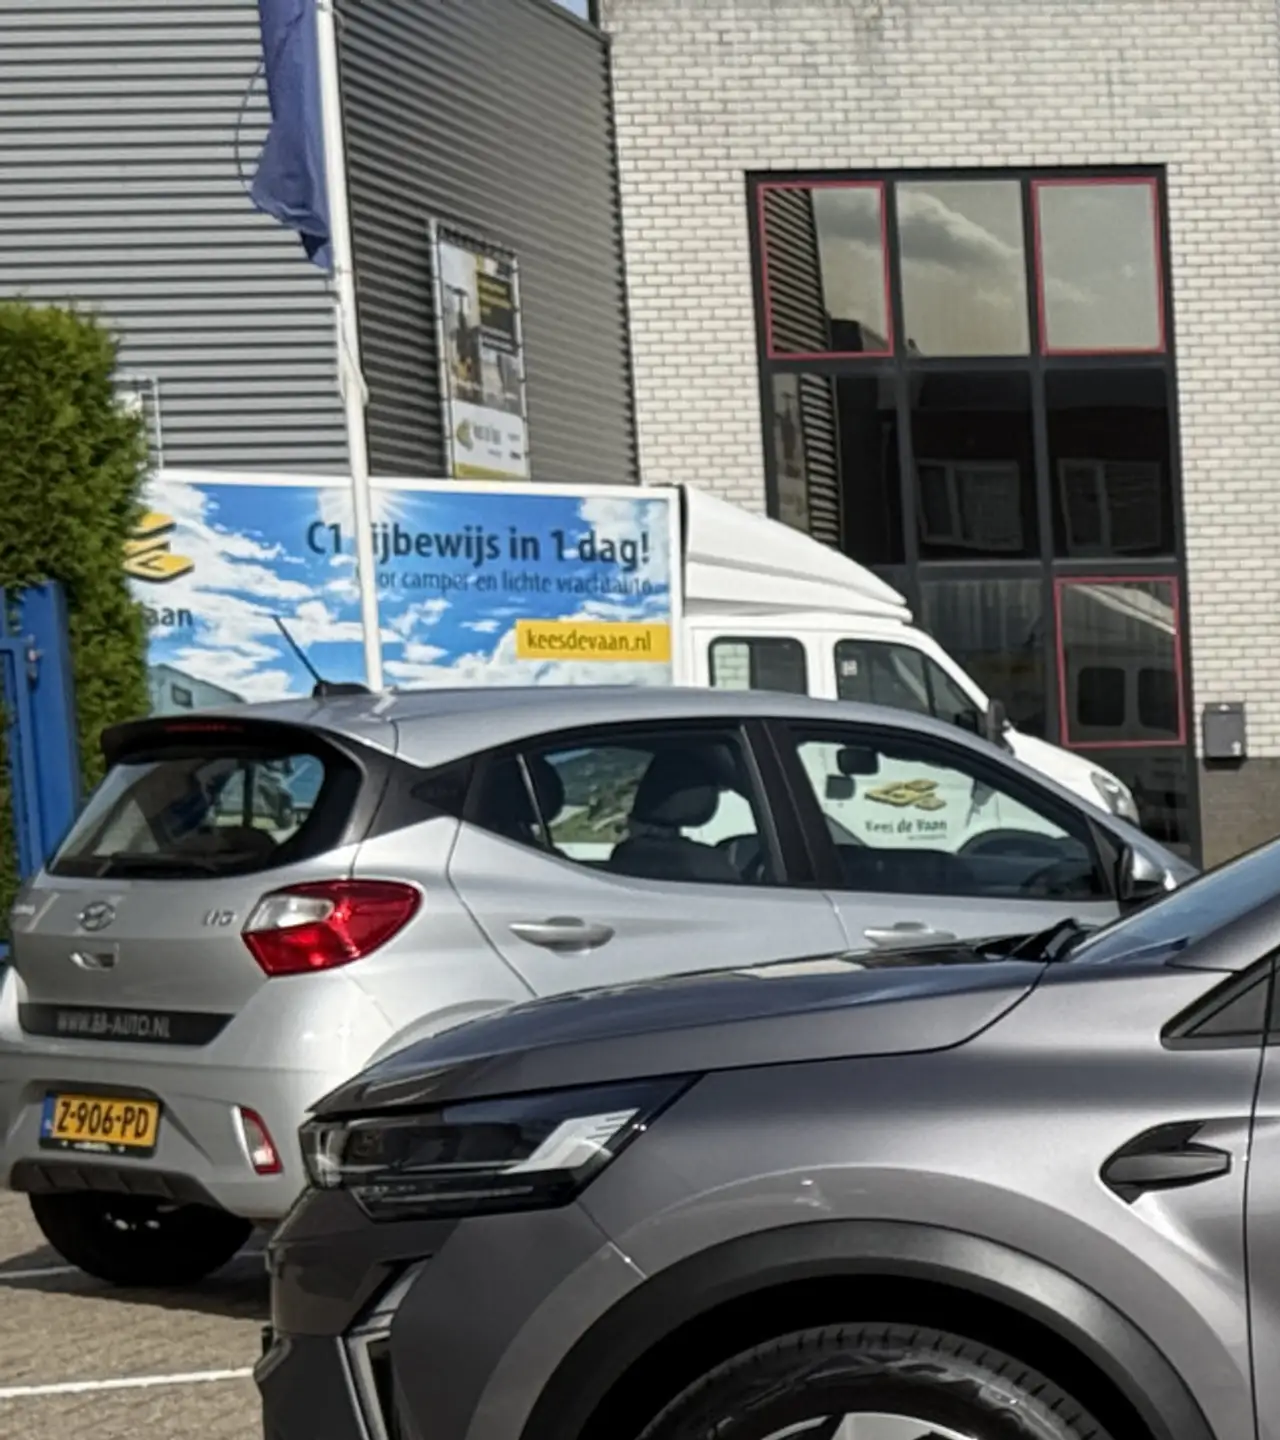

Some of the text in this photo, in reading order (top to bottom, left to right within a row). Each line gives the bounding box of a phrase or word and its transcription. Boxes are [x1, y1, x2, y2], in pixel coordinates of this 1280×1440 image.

[306, 521, 650, 573] C1 ijbewijs in 1 dag!
[144, 607, 194, 628] aan
[527, 629, 652, 652] keesdevaan.nl
[57, 1101, 150, 1139] Z-906-PD
